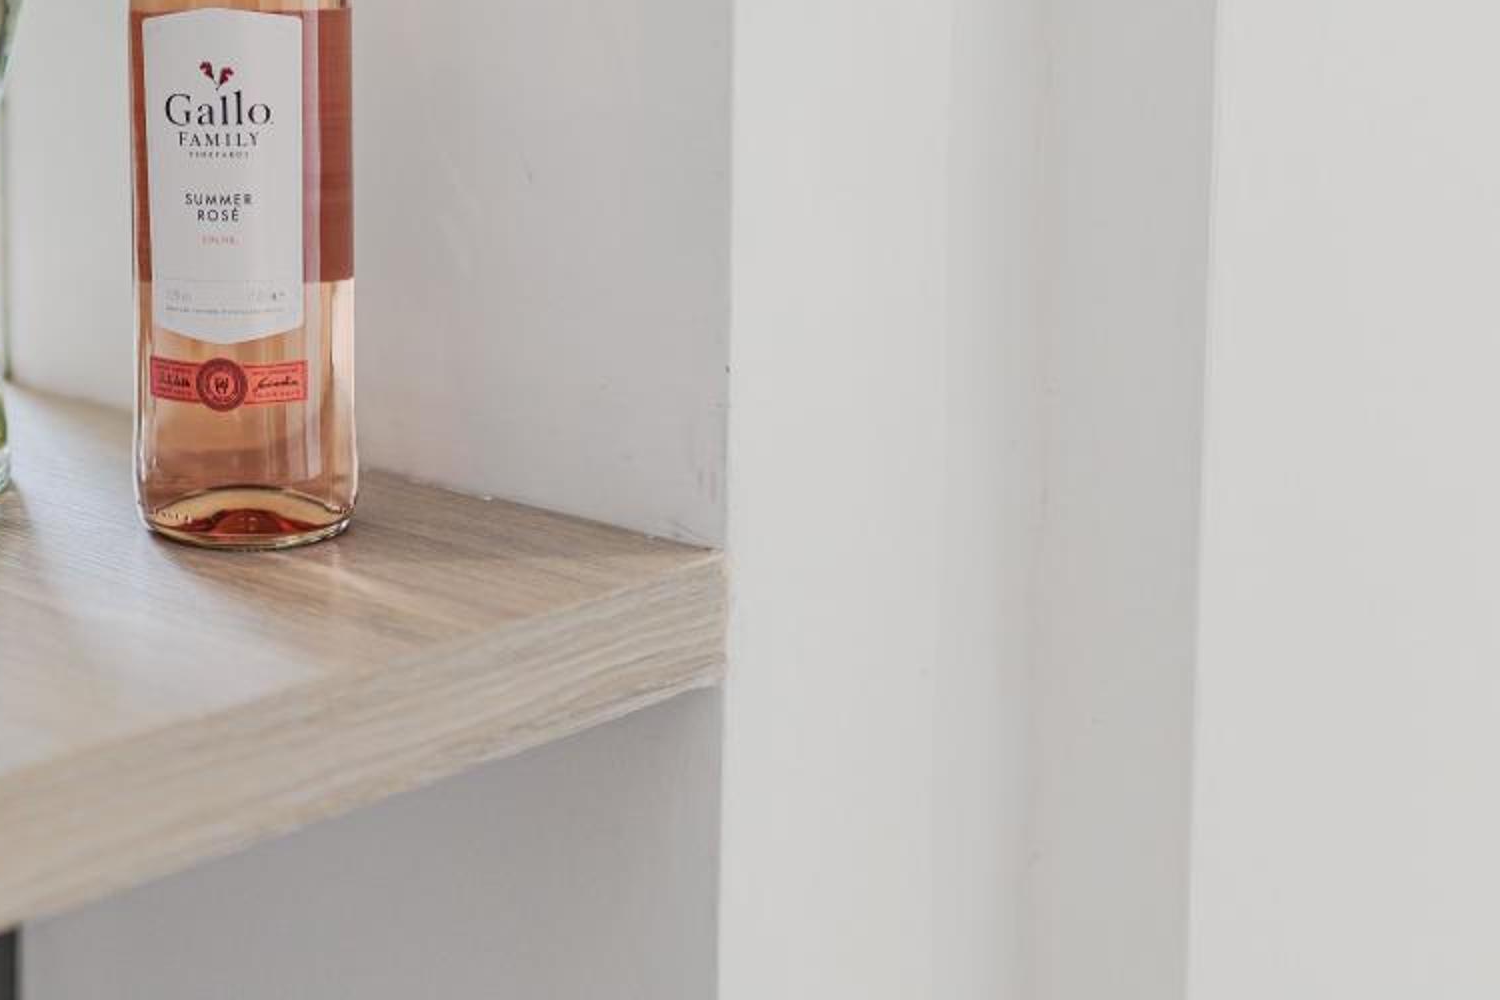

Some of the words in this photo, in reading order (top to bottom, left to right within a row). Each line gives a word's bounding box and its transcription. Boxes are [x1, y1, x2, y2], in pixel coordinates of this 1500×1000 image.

[165, 90, 271, 127] Gallo
[179, 132, 259, 147] FAMILY
[184, 193, 252, 206] SUMMER
[197, 207, 239, 222] ROSÉ
